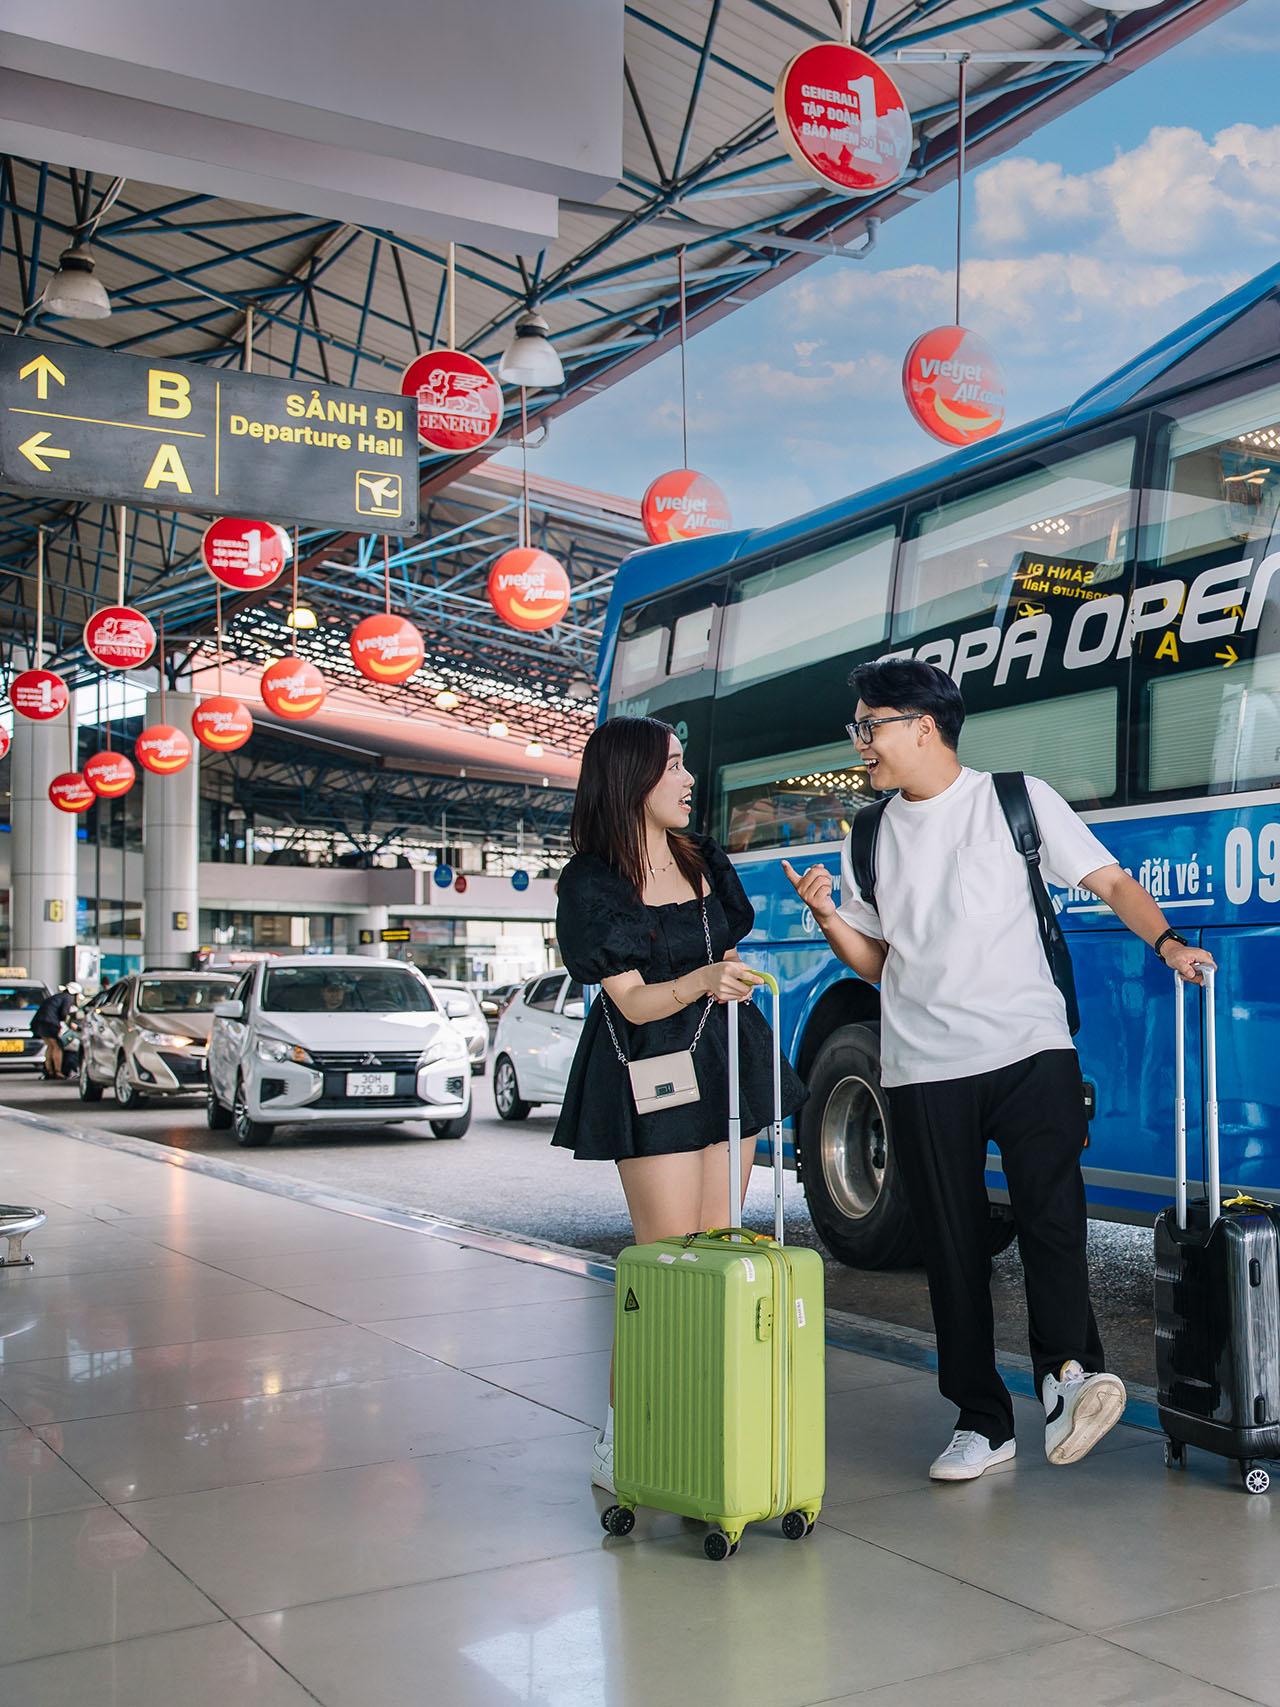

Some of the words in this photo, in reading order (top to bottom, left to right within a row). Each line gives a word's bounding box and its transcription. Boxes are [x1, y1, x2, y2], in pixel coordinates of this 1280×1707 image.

[801, 85, 858, 108] GENERALI
[147, 369, 192, 419] B
[286, 390, 367, 426] SẢNH
[375, 408, 403, 431] ĐI
[230, 415, 351, 449] Departure
[358, 433, 403, 457] Hall
[418, 413, 490, 436] GENERALI
[144, 444, 192, 493] A
[1176, 853, 1200, 896] vé
